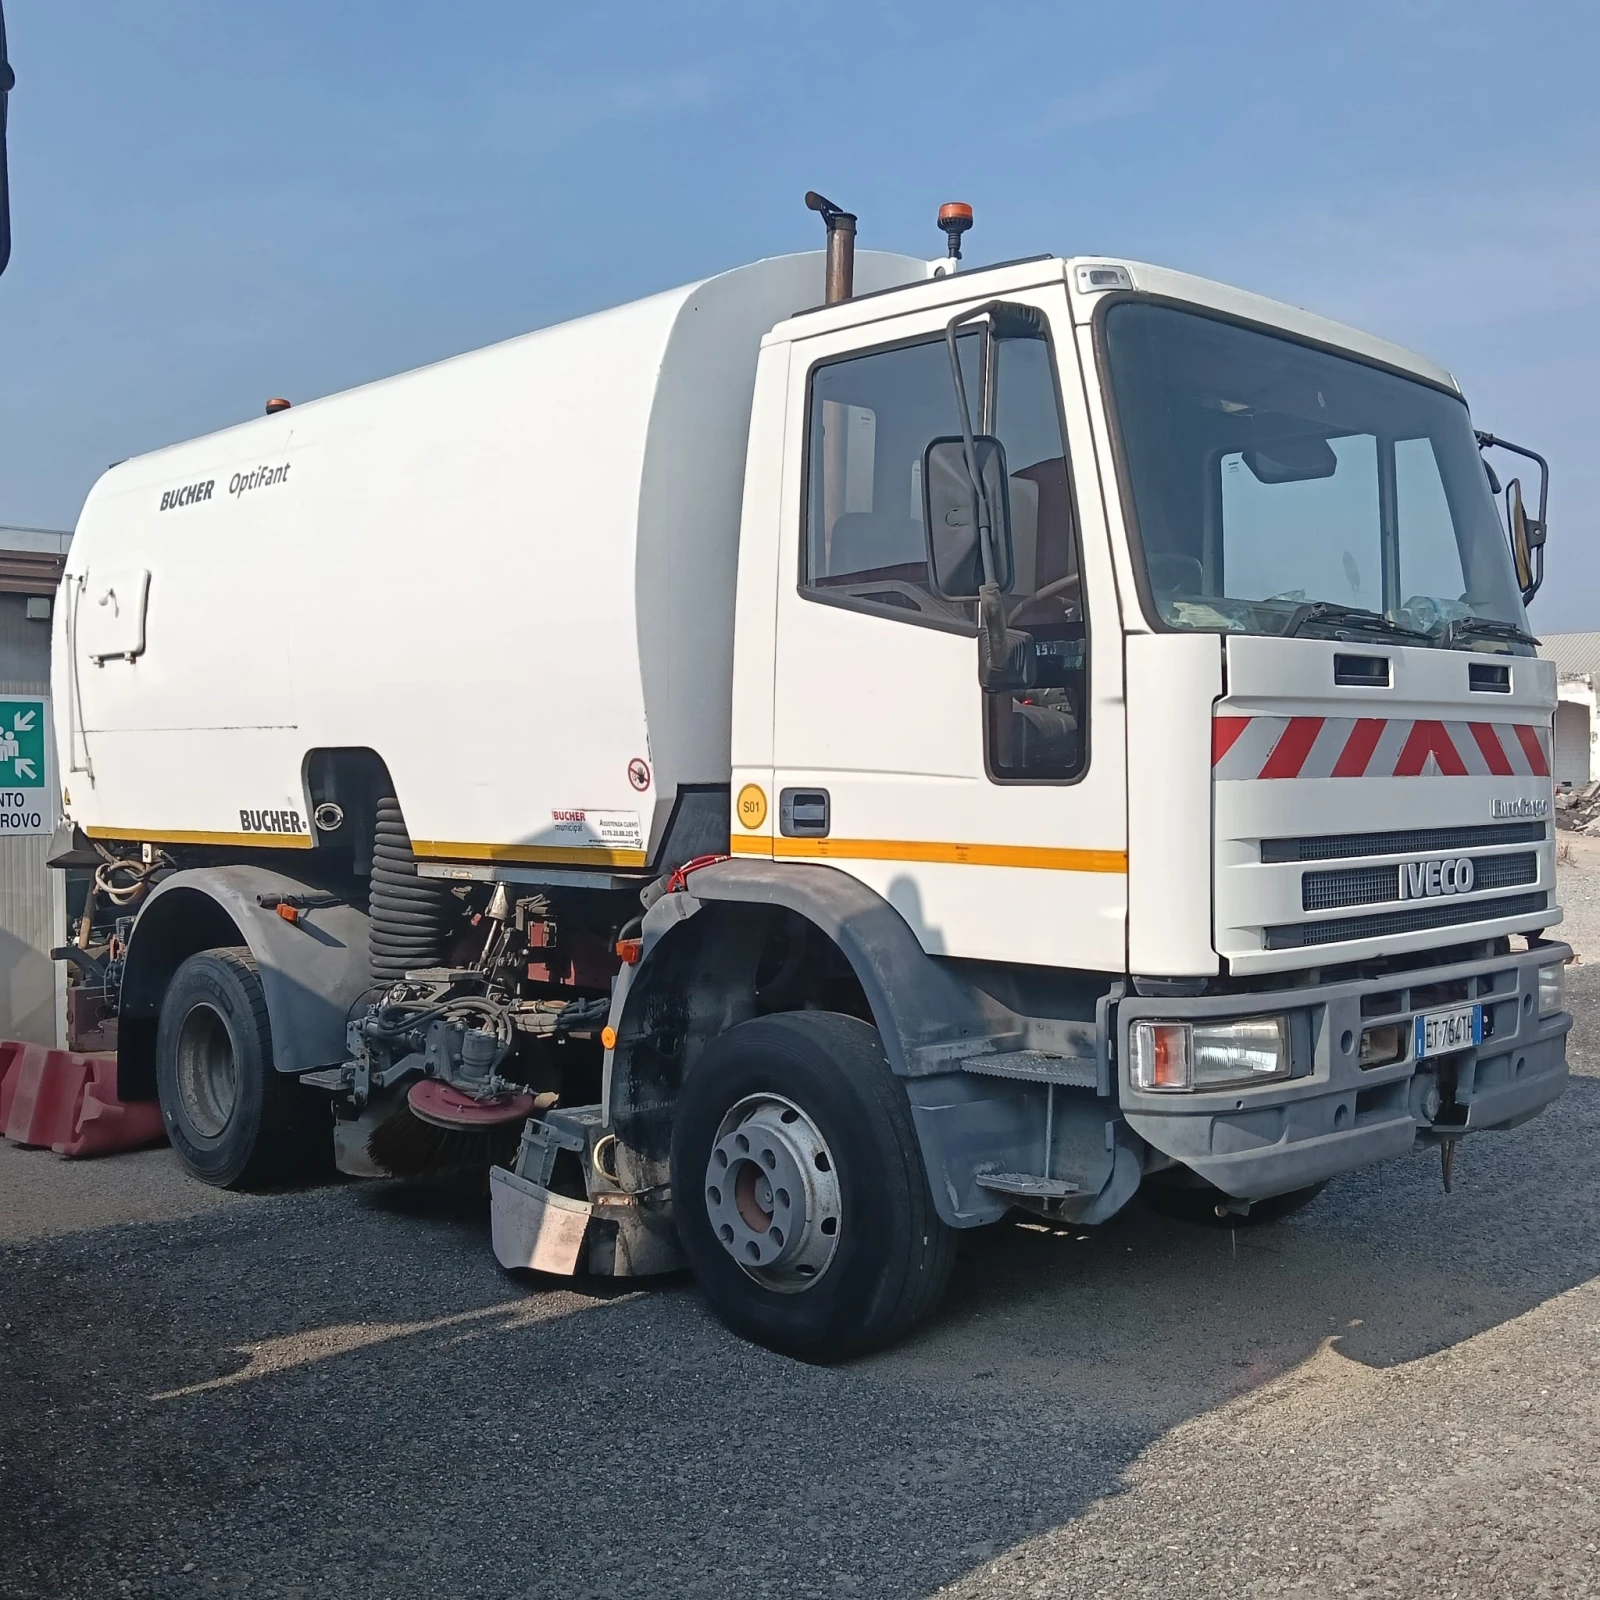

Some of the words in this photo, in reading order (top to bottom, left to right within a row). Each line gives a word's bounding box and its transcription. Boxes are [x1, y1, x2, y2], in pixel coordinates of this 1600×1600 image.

[160, 480, 215, 511] BUCHER
[229, 462, 291, 499] OptiFant
[743, 801, 760, 813] S01
[553, 811, 586, 822] BUCHER
[555, 822, 583, 833] municipal
[1398, 858, 1474, 899] IVECO
